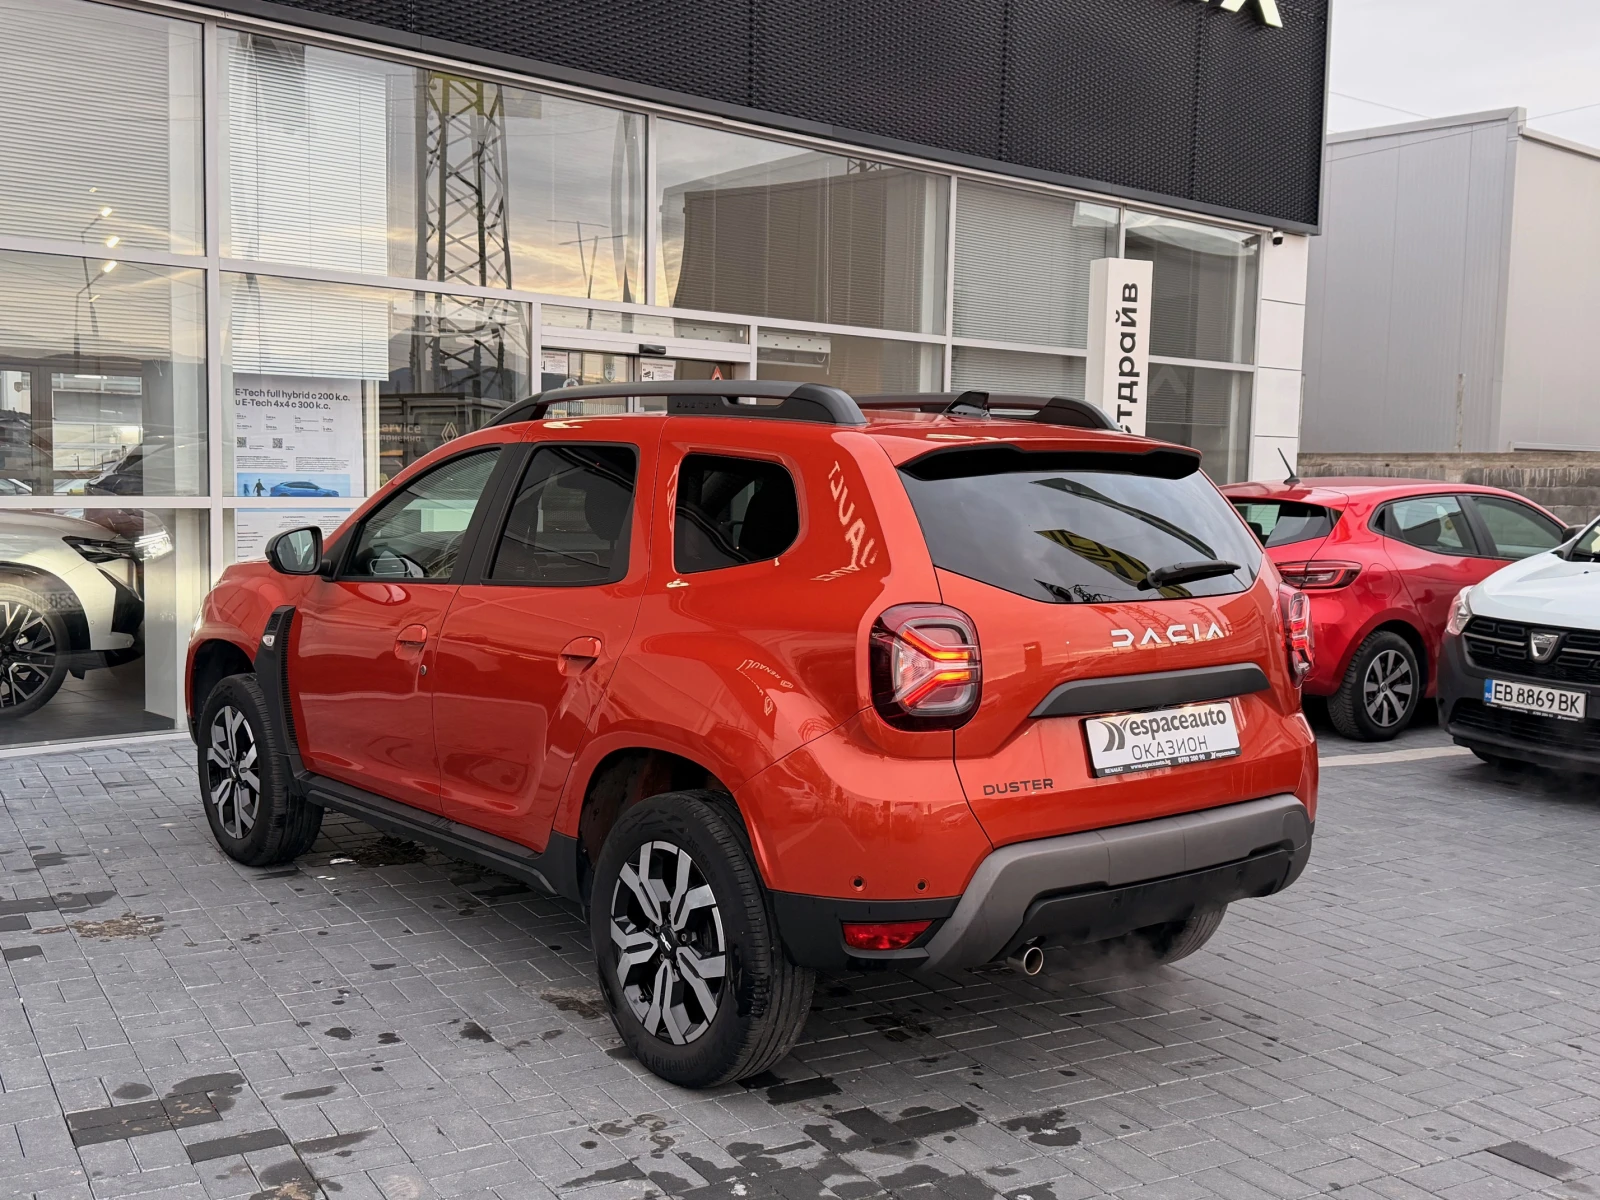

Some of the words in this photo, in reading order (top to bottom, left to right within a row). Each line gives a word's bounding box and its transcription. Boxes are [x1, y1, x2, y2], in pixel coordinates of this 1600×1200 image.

[235, 388, 265, 397] E-Tech
[267, 389, 280, 398] full
[282, 390, 310, 400] hybrid
[318, 392, 335, 400] 200
[242, 398, 273, 407] E-Tech
[298, 401, 315, 409] 300
[379, 422, 421, 434] ervice
[1111, 621, 1225, 648] DACIA
[1494, 683, 1513, 702] EB
[1516, 687, 1555, 709] 8869
[1558, 693, 1580, 714] BK
[1129, 707, 1227, 740] espaceauto
[1131, 735, 1209, 761] ОКАЗИОН
[983, 778, 1054, 796] DUSTER
